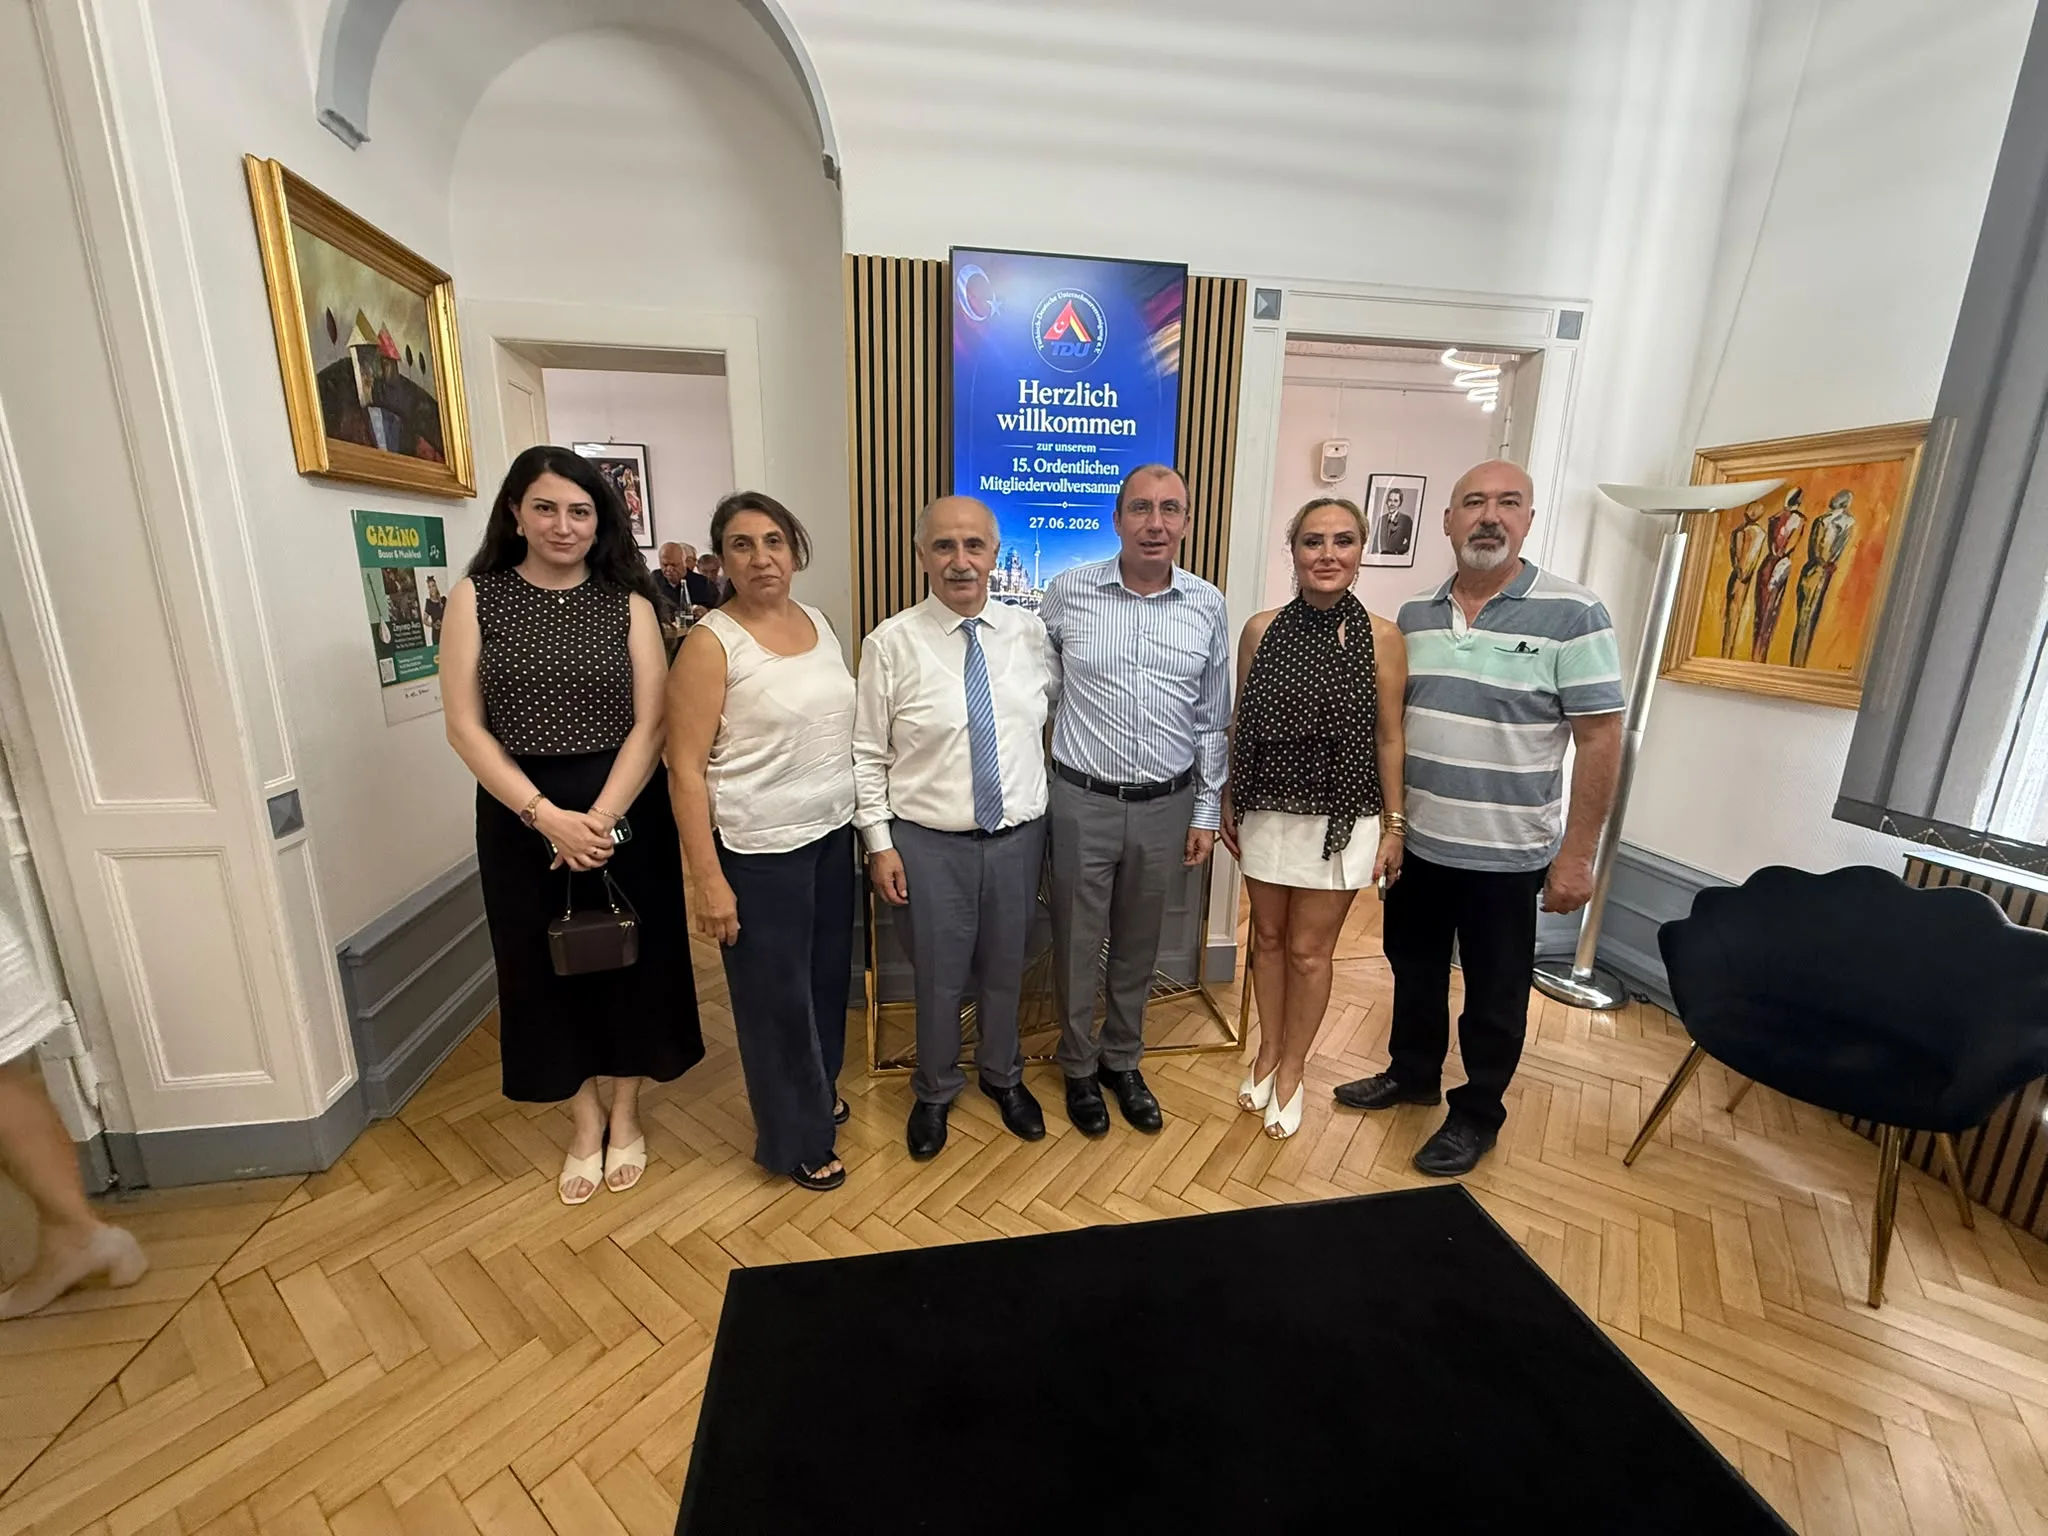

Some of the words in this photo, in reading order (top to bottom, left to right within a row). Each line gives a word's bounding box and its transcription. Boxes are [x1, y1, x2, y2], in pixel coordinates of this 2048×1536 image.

[1051, 341, 1091, 358] TDU
[1018, 379, 1118, 408] Herzlich
[997, 408, 1137, 436] willkommen
[1036, 443, 1053, 452] zur
[1055, 443, 1097, 454] unserem
[1012, 457, 1031, 473] 15.
[1034, 458, 1119, 476] Ordentlichen
[1029, 517, 1100, 530] 27.06.2026
